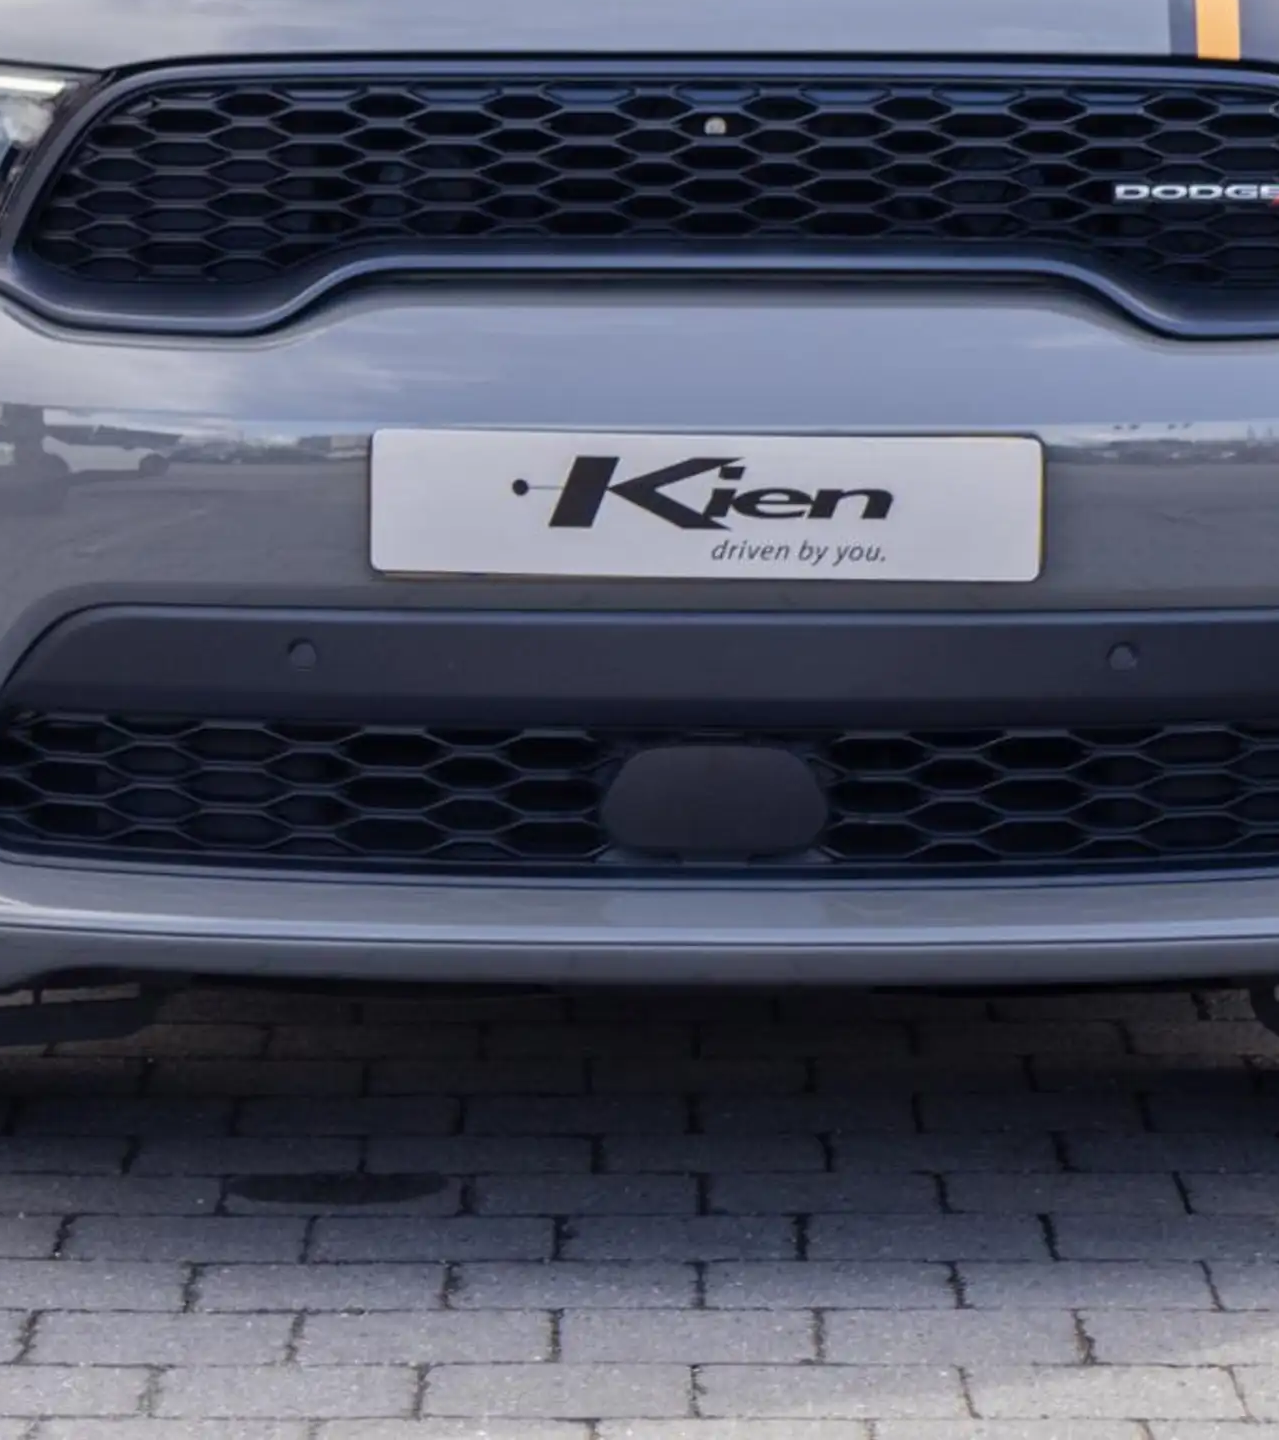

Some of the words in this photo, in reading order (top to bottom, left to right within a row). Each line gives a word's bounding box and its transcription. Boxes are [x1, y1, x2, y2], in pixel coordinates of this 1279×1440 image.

[548, 455, 894, 530] Kien
[710, 539, 791, 561] driven
[797, 539, 829, 567] by
[831, 545, 886, 567] you.
